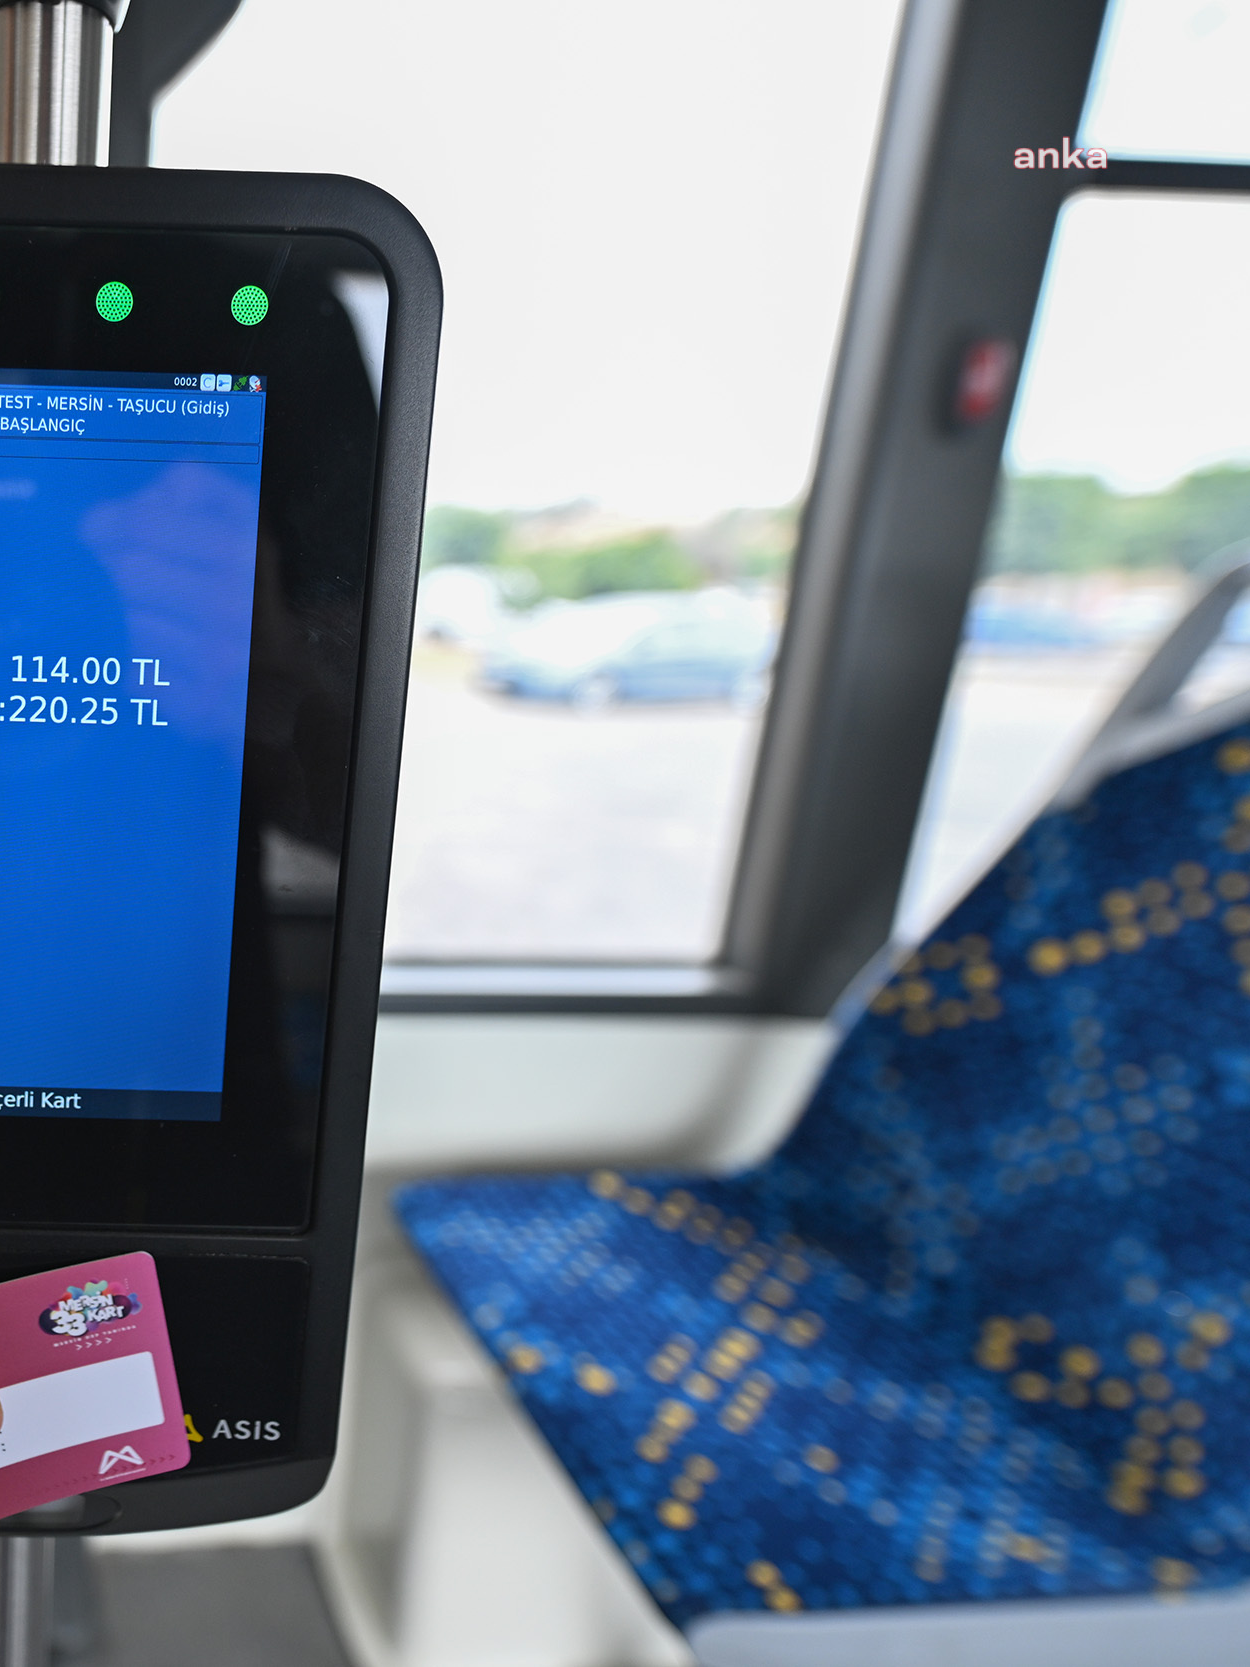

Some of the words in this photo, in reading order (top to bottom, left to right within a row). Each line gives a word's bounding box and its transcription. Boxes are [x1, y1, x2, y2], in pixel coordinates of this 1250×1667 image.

[174, 376, 198, 387] 0002
[46, 394, 104, 412] MERSİN
[117, 398, 176, 416] TAŞUCU
[181, 400, 230, 418] (Gidiş)
[0, 416, 86, 436] BAŞLANGIÇ
[11, 655, 121, 685] 114.00
[131, 658, 171, 687] TL
[129, 697, 169, 727] TL
[41, 1091, 82, 1109] Kart
[50, 1310, 88, 1337] 33
[87, 1305, 125, 1322] KART
